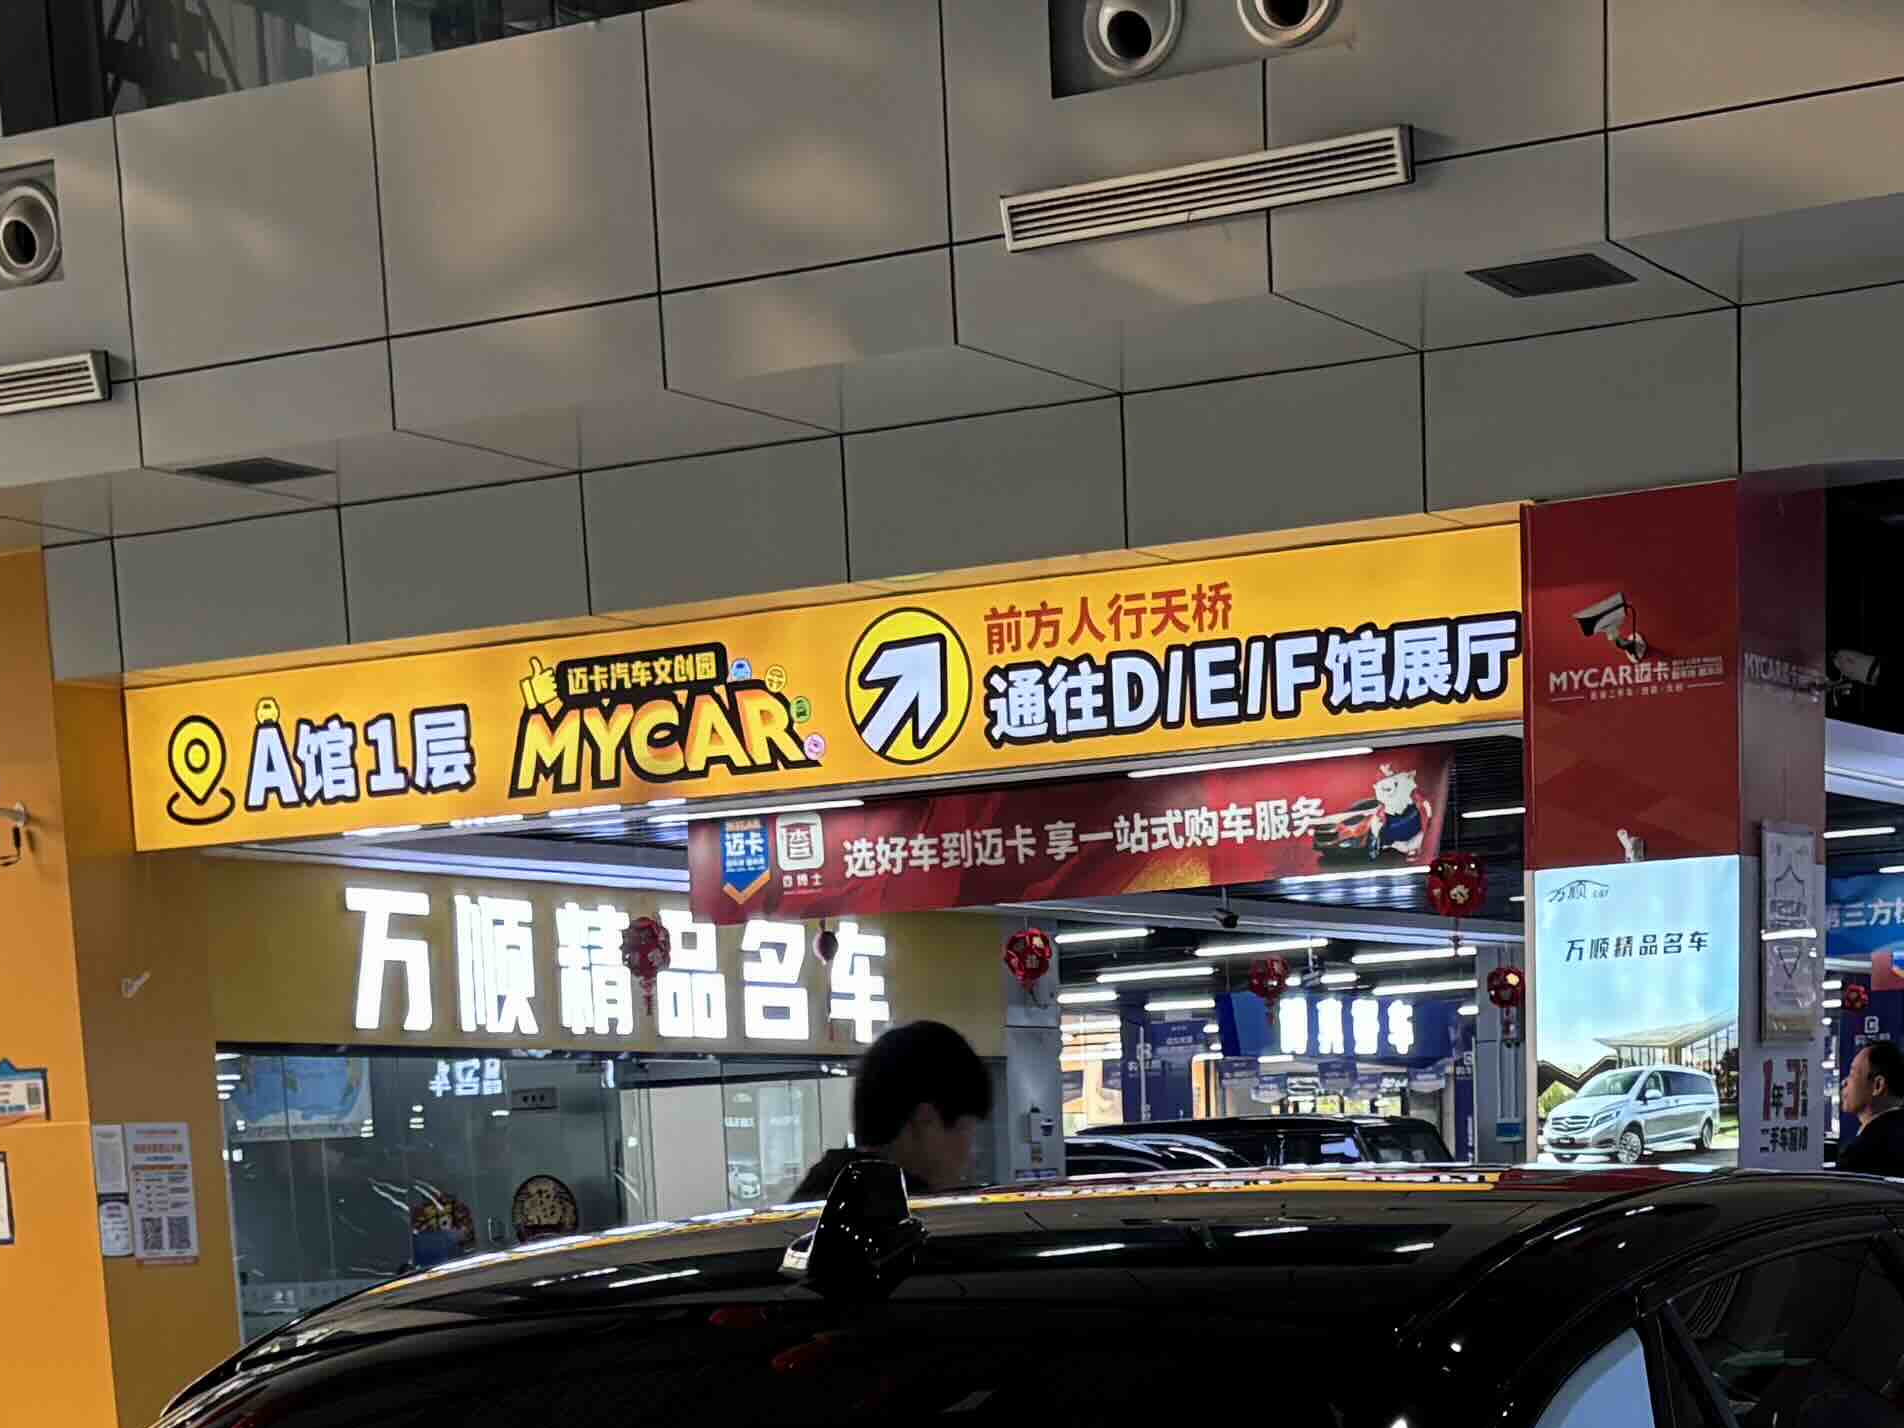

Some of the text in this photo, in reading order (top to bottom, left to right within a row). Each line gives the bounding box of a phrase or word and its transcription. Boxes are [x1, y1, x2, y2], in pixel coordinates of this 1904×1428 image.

[984, 581, 1232, 656] 前方人行天桥
[567, 651, 718, 695] 迈卡汽车文创园
[246, 704, 474, 810] A馆1层
[513, 688, 818, 797] MYCAR
[843, 795, 1327, 880] 选好车到迈卡 享一站式购车服务
[345, 887, 891, 1044] 万顺精品名车
[1565, 930, 1709, 962] 万顺精品名车
